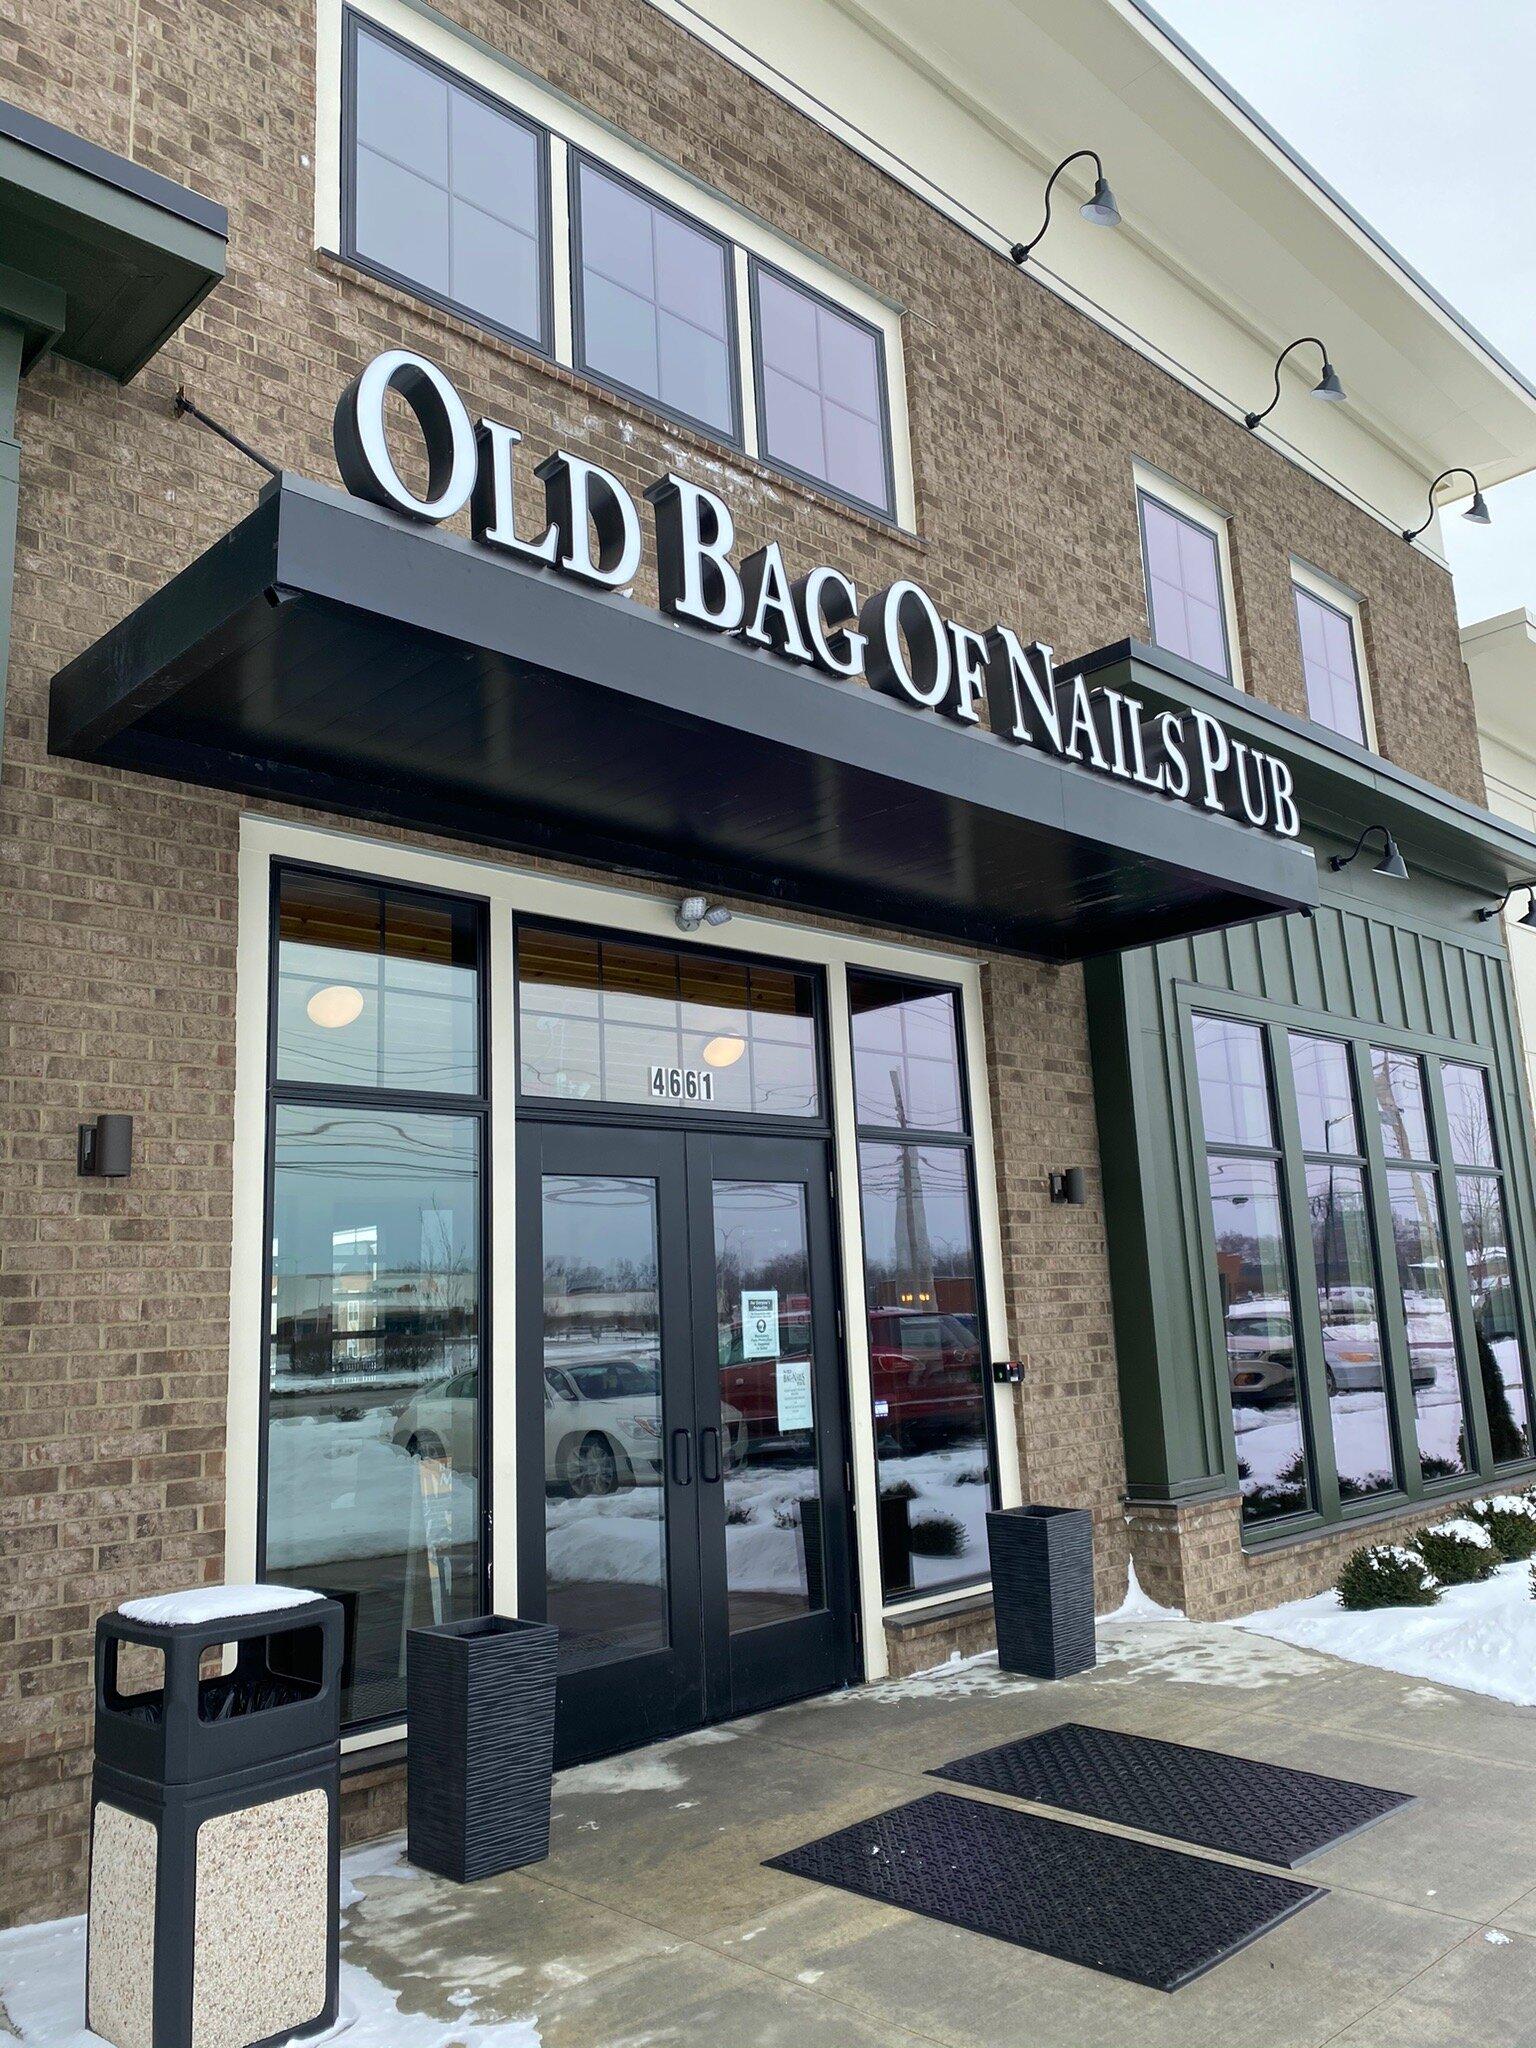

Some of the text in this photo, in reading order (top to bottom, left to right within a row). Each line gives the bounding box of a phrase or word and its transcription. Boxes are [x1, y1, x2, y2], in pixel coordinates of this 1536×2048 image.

[355, 348, 1300, 837] OLD BAG OF NAILS PUB
[652, 1067, 712, 1100] 4661
